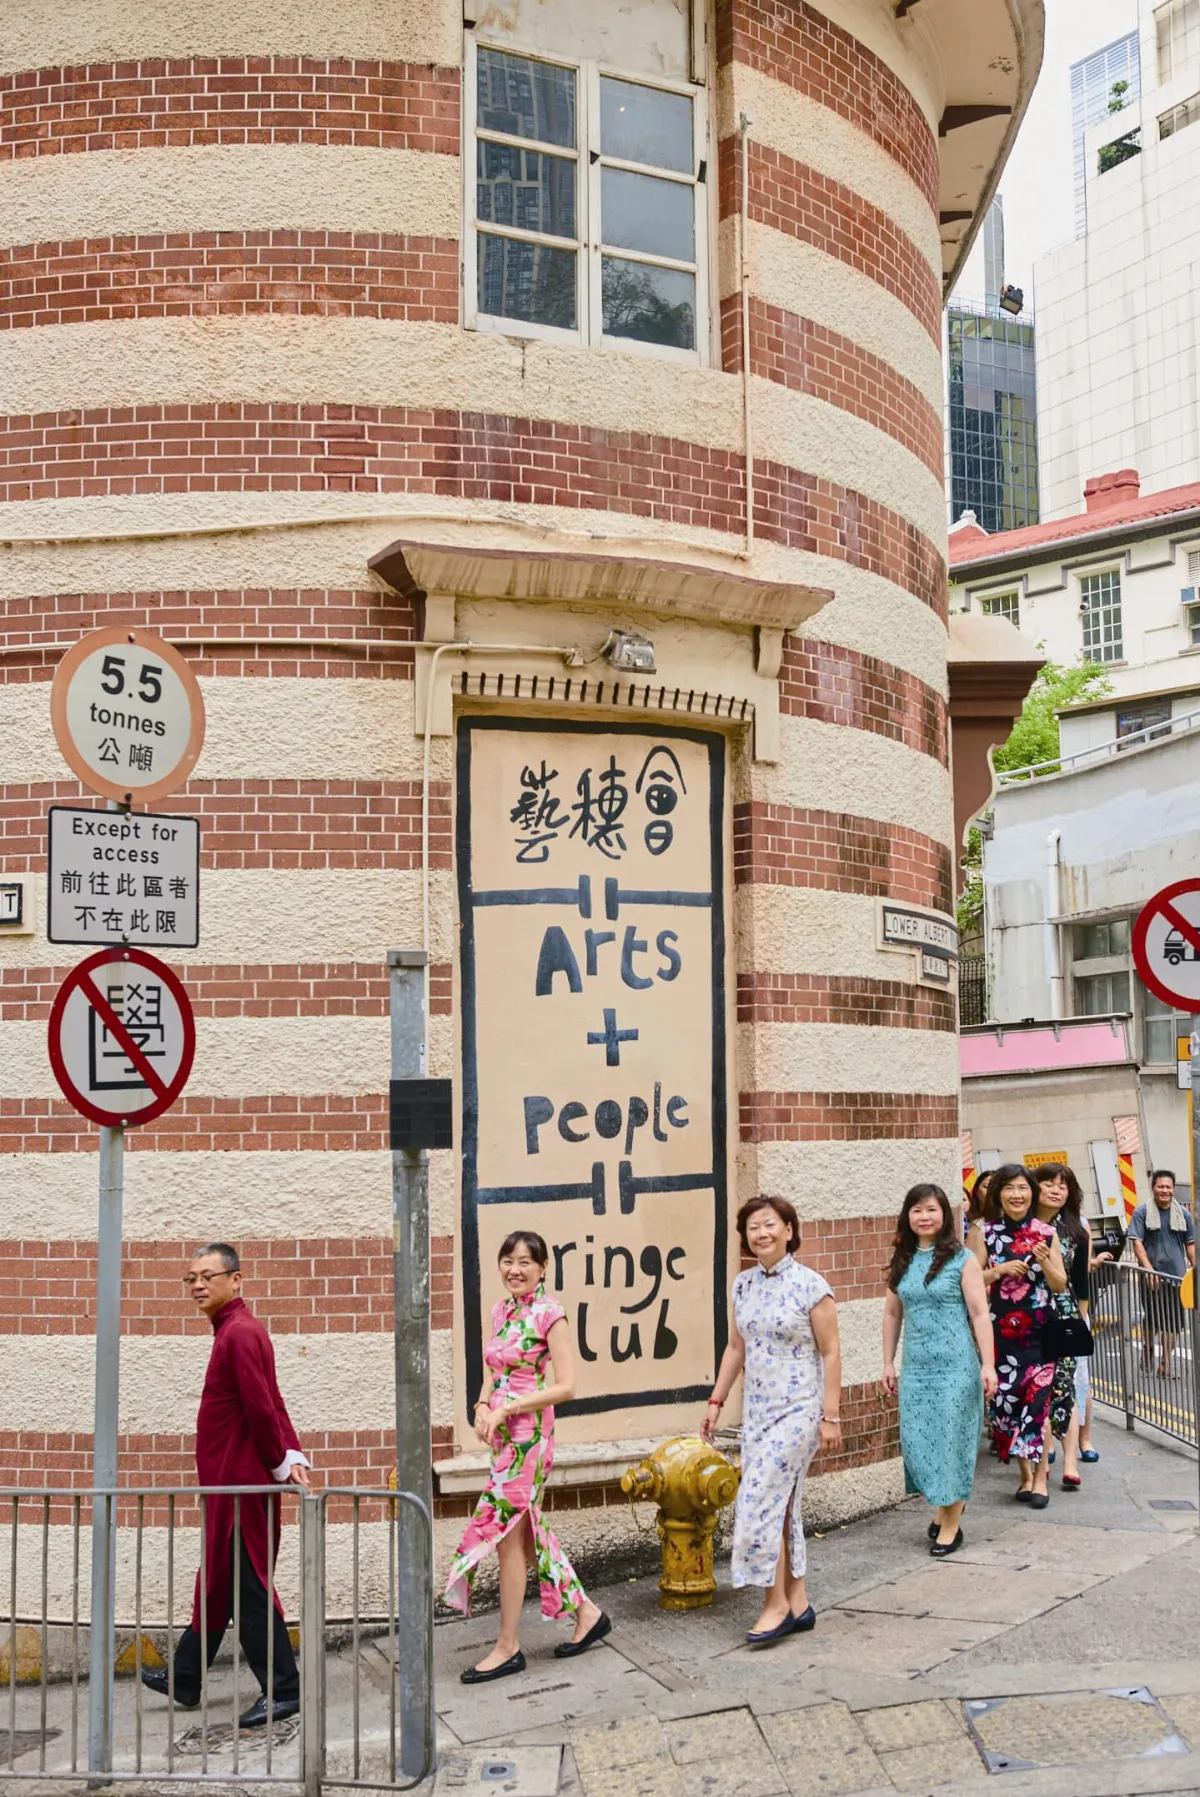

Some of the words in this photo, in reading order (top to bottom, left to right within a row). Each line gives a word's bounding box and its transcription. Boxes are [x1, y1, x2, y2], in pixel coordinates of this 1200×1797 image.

[101, 655, 163, 704] 5.5
[90, 703, 166, 736] tonnes
[98, 737, 154, 772] 公噸
[72, 818, 141, 841] Except
[152, 823, 178, 842] for
[93, 846, 160, 865] access
[60, 870, 190, 899] 前往此區者
[74, 905, 177, 933] 不在此限
[885, 916, 918, 936] LOWER
[535, 925, 682, 996] Arts
[523, 1081, 690, 1155] People
[552, 1235, 687, 1314] ringe
[577, 1298, 678, 1363] lub
